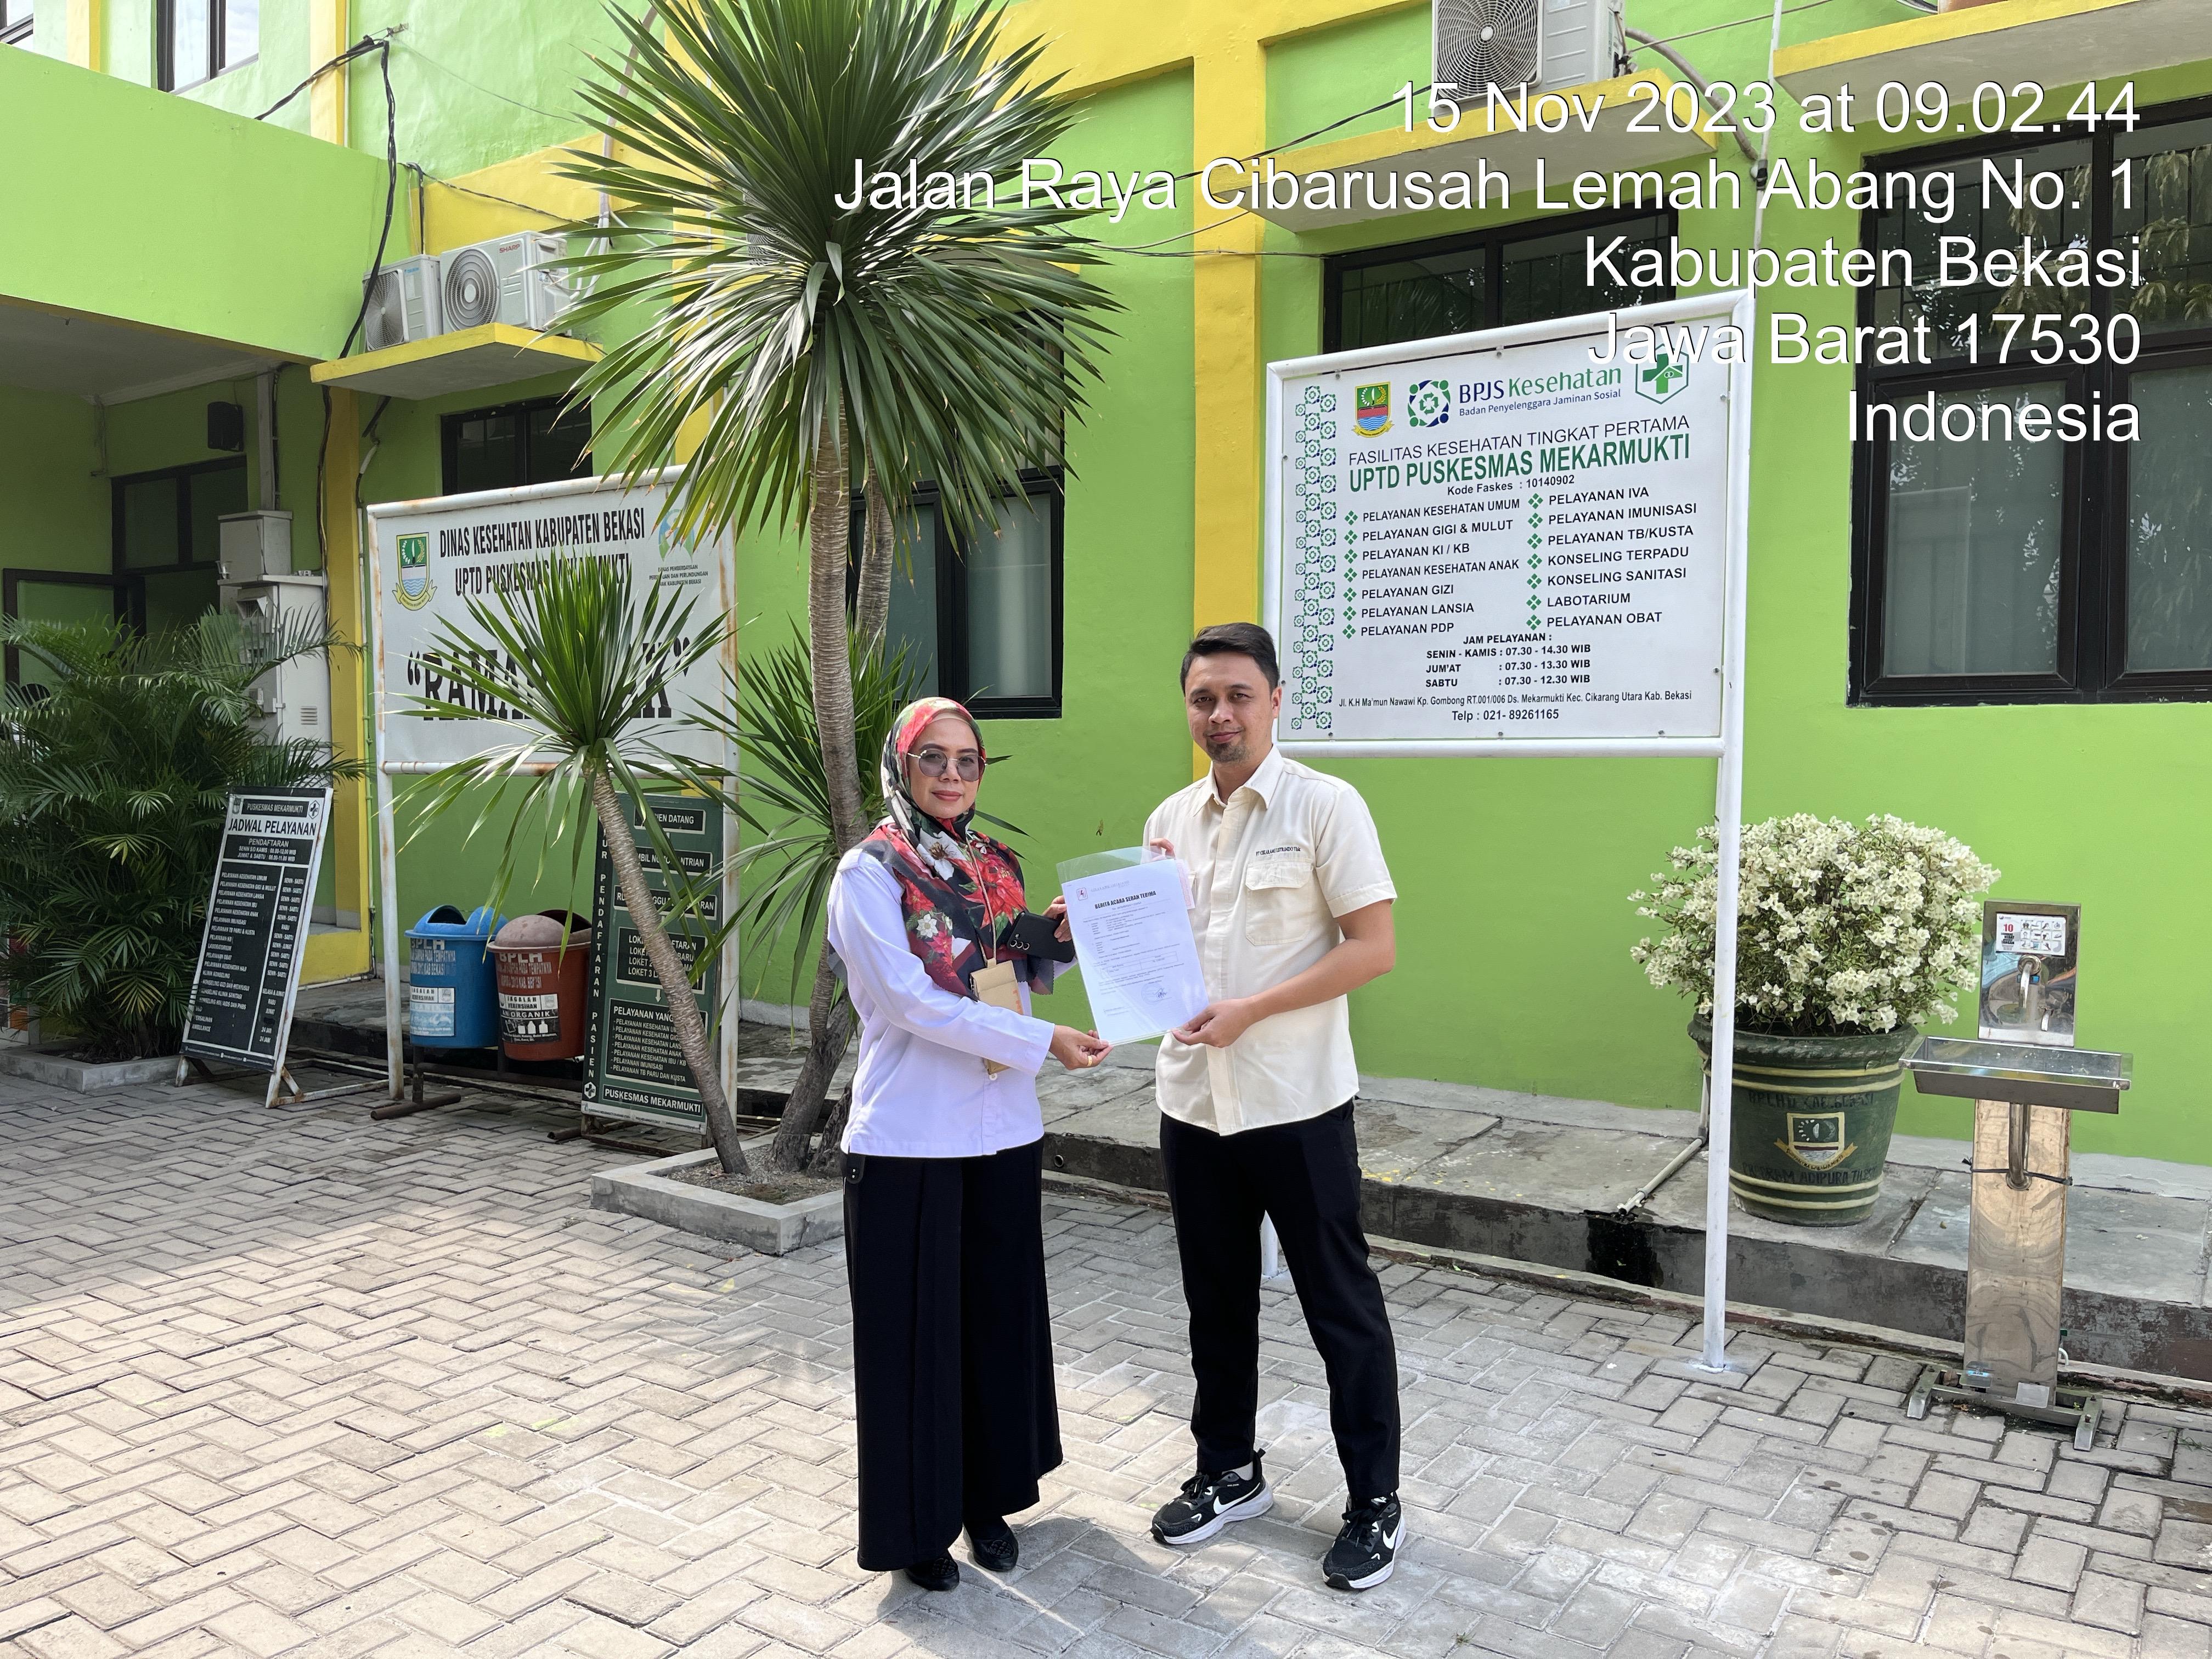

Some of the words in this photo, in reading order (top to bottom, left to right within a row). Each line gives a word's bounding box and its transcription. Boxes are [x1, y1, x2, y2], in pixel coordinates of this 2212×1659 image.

[500, 244, 520, 253] SHARP
[1460, 381, 1504, 403] BPJS
[1509, 368, 1621, 397] Kesehatan
[1460, 407, 1486, 416] Badan
[1489, 400, 1550, 413] Penyelenggara
[1553, 394, 1591, 405] Jaminan
[1594, 389, 1621, 399] Sosial
[1350, 445, 1421, 465] FASILITAS
[1428, 435, 1521, 456] KESEHATAN
[1527, 425, 1599, 445] TINGKAT
[1605, 415, 1690, 437] PERTAMA
[1351, 465, 1399, 492] UPTD
[1407, 450, 1532, 486] PUSKESMAS
[1541, 433, 1690, 473] MEKARMUKTI
[1448, 485, 1473, 495] Kode
[1477, 482, 1513, 493] Faskes
[1526, 475, 1574, 488] 10140902
[1549, 489, 1624, 505] PELAYANAN
[1629, 487, 1649, 498] IVA
[1363, 508, 1420, 522] PELAYANAN
[1424, 502, 1483, 516] KESEHATAN
[1488, 499, 1519, 510] UMUM
[1549, 509, 1623, 524] PELAYANAN
[1629, 503, 1696, 518] IMUNISASI
[440, 527, 470, 557] DINAS
[473, 521, 532, 554] KESEHATAN
[535, 513, 600, 548] KABUPATEN
[603, 508, 644, 541] BEKASI
[1363, 527, 1428, 541] PELAYANAN
[1433, 524, 1455, 535] GIGI
[1460, 523, 1468, 533] &
[1472, 520, 1513, 532] MULUT
[1549, 531, 1623, 545] PELAYANAN
[1628, 526, 1693, 539] TB/KUSTA
[1363, 546, 1428, 560] PELAYANAN
[1433, 545, 1443, 555] KI
[1454, 543, 1469, 553] KB
[1548, 551, 1622, 566] KONSELING
[1627, 546, 1688, 560] TERPADU
[1363, 566, 1420, 579] PELAYANAN
[1424, 562, 1485, 574] KESEHATAN
[1488, 560, 1519, 571] ANAK
[1548, 572, 1621, 586] KONSELING
[1626, 568, 1685, 580] SANITASI
[455, 566, 482, 596] UPTD
[1362, 586, 1427, 599] PELAYANAN
[1432, 585, 1453, 595] GIZI
[1548, 593, 1630, 607] LABOTARIUM
[1362, 606, 1427, 618] PELAYANAN
[1432, 603, 1474, 614] LANSIA
[1548, 614, 1622, 627] PELAYANAN
[1627, 612, 1662, 623] OBAT
[1362, 624, 1426, 636] PELAYANAN
[1431, 623, 1454, 633] PDP
[1463, 636, 1483, 644] JAM
[1487, 633, 1545, 643] PELAYANAN
[1426, 650, 1455, 658] SENIN
[1465, 648, 1496, 657] KAMIS
[1506, 647, 1532, 656] 07.30
[1542, 645, 1567, 654] 14.30
[1571, 645, 1590, 653] WIB
[1505, 662, 1531, 670] 07.30
[1541, 661, 1567, 669] 13.30
[1571, 659, 1590, 668] WIB
[1505, 676, 1531, 685] 07.30
[1541, 675, 1567, 684] 12.30
[1571, 675, 1590, 683] WIB
[1362, 698, 1387, 706] Ma'mun
[1418, 697, 1427, 707] Kp.
[1431, 697, 1464, 706] Gombong
[1467, 695, 1505, 704] RT.001/006
[1508, 695, 1519, 703] Ds.
[1522, 693, 1564, 702] Mekarmukti
[1567, 693, 1582, 702] Kec.
[1585, 693, 1619, 703] Cikarang
[1622, 692, 1642, 701] Utara
[1645, 691, 1662, 700] Kab.
[1665, 691, 1691, 699] Bekasi
[1452, 711, 1472, 723] Telp
[1483, 710, 1505, 720] 021-
[1509, 709, 1559, 719] 89261165
[247, 803, 273, 812] PUSKESMAS
[274, 805, 303, 813] MEKARMUKTI
[668, 815, 694, 824] DATANG
[228, 819, 262, 833] JADWAL
[264, 821, 317, 836] PELAYANAN
[249, 838, 289, 848] PENDAFTARAN
[680, 857, 704, 867] NTRIAN
[593, 874, 606, 997] PENDAFTARAN
[500, 953, 543, 963] BPLH
[629, 957, 648, 967] LOKET
[628, 967, 647, 977] LOKET
[613, 1006, 654, 1019] PELAYANAN
[655, 1012, 674, 1022] YANG
[616, 1018, 642, 1028] PELAYANAN
[643, 1023, 669, 1031] KESEHATAN
[616, 1026, 641, 1035] PELAYANAN
[642, 1030, 669, 1039] KESEHATAN
[588, 1012, 598, 1077] PASIEN
[615, 1034, 641, 1043] PELAYANAN
[642, 1038, 668, 1047] KESEHATAN
[614, 1042, 640, 1051] PELAYANAN
[641, 1046, 668, 1056] KESEHATAN
[614, 1049, 640, 1059] PELAYANAN
[641, 1053, 667, 1063] KESEHATAN
[613, 1057, 640, 1066] PELAYANAN
[640, 1061, 663, 1070] IMUNISASI
[613, 1065, 639, 1074] PELAYANAN
[670, 1074, 686, 1082] KUSTA
[605, 1088, 648, 1104] PUSKESMAS
[651, 1096, 701, 1113] MEKARMUKTI
